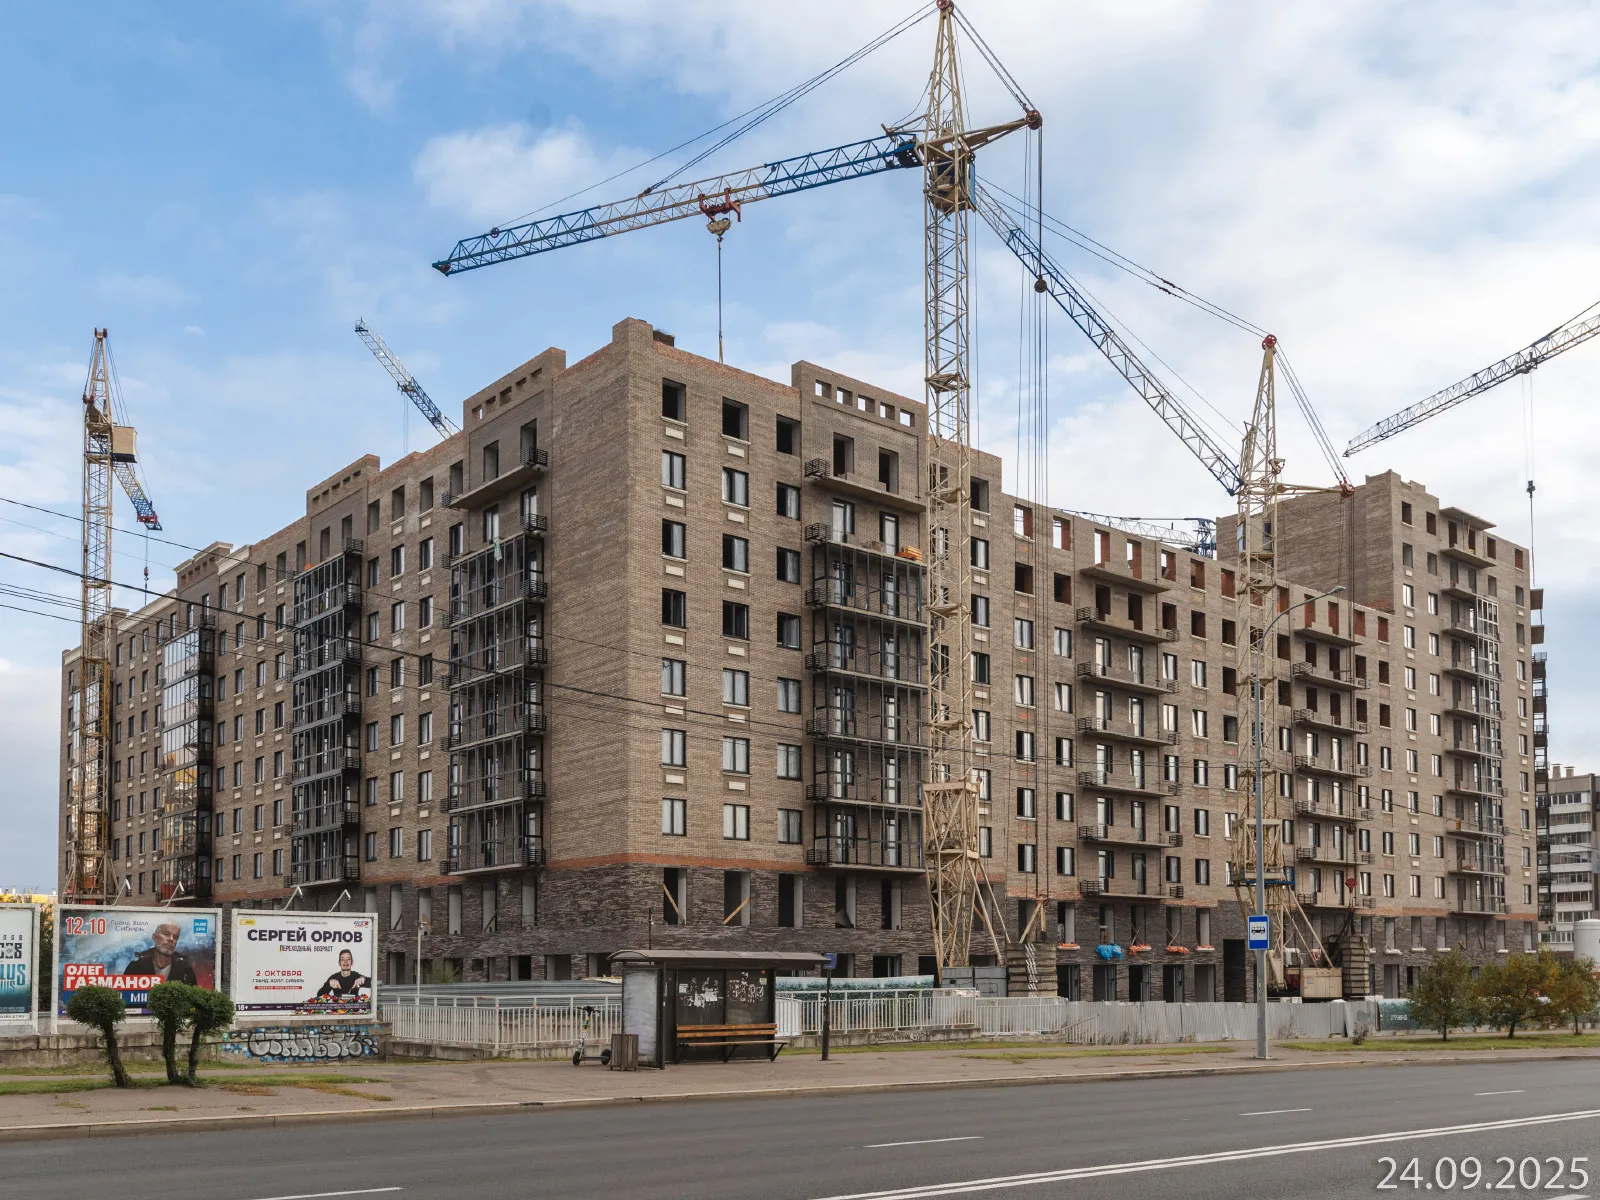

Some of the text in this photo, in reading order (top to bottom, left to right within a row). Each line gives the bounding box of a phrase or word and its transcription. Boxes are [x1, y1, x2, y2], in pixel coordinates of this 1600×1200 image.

[66, 916, 106, 935] 12.10
[247, 927, 363, 943] СЕРГЕЙ ОРЛОВ
[279, 944, 312, 952] ПЕРЕХОДНЫЙ
[66, 965, 103, 976] ОЛЕГ
